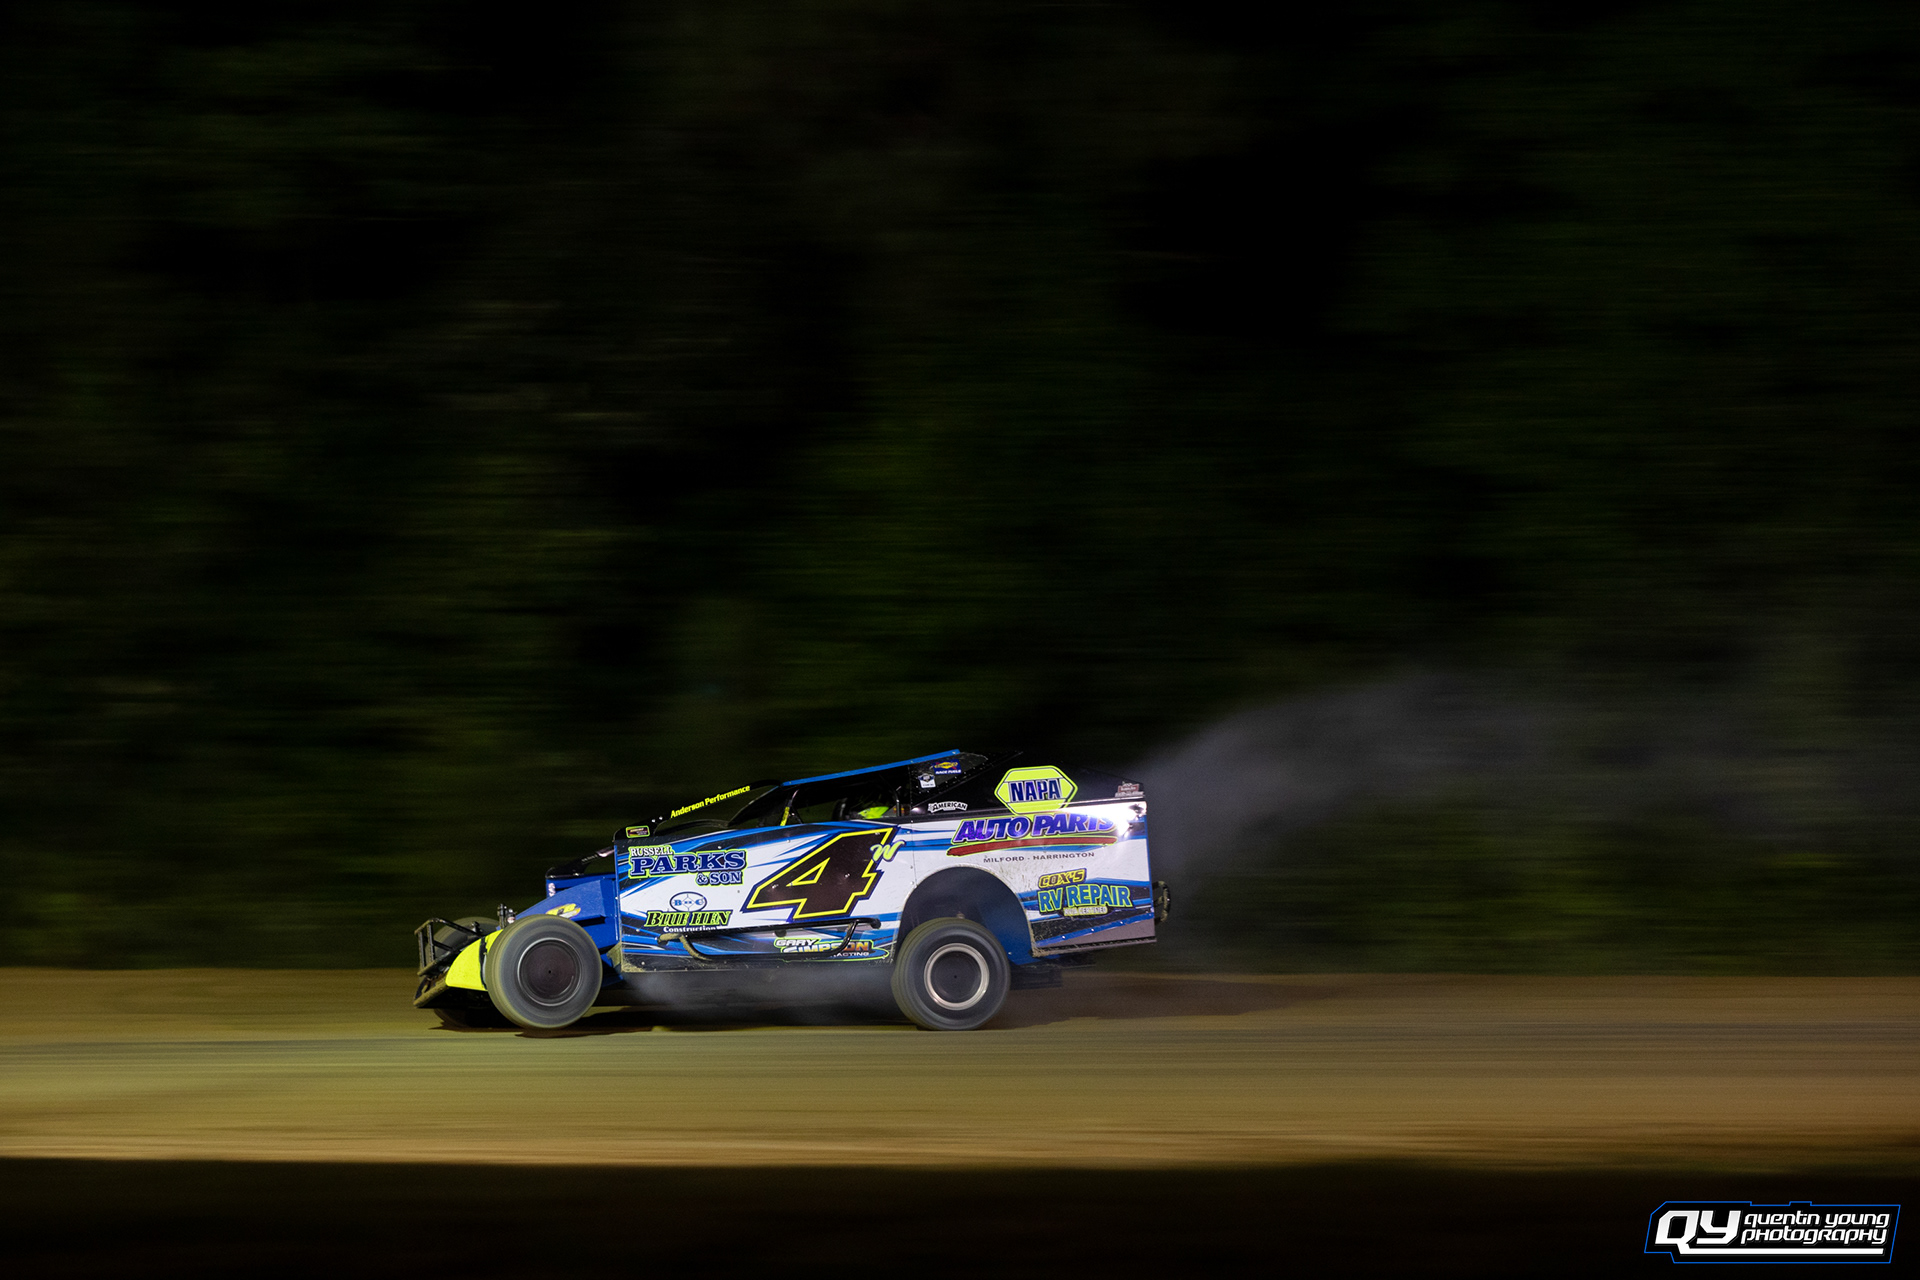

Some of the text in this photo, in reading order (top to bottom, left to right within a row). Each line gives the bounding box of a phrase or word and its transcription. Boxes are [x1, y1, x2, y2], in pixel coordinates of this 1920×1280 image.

[1009, 780, 1061, 802] NAPA
[670, 785, 751, 818] Anderson Performance
[932, 802, 967, 811] AMERICAN
[954, 816, 1032, 843] AUTO
[630, 846, 673, 857] RUSSELL
[983, 855, 1025, 863] MILFORD
[1032, 852, 1095, 860] HARRINGTON
[630, 850, 747, 877] PARKS
[696, 870, 743, 885] & SON
[1040, 870, 1085, 888] COX'S
[1038, 884, 1133, 913] RV REPAIR
[689, 910, 732, 926] HEN
